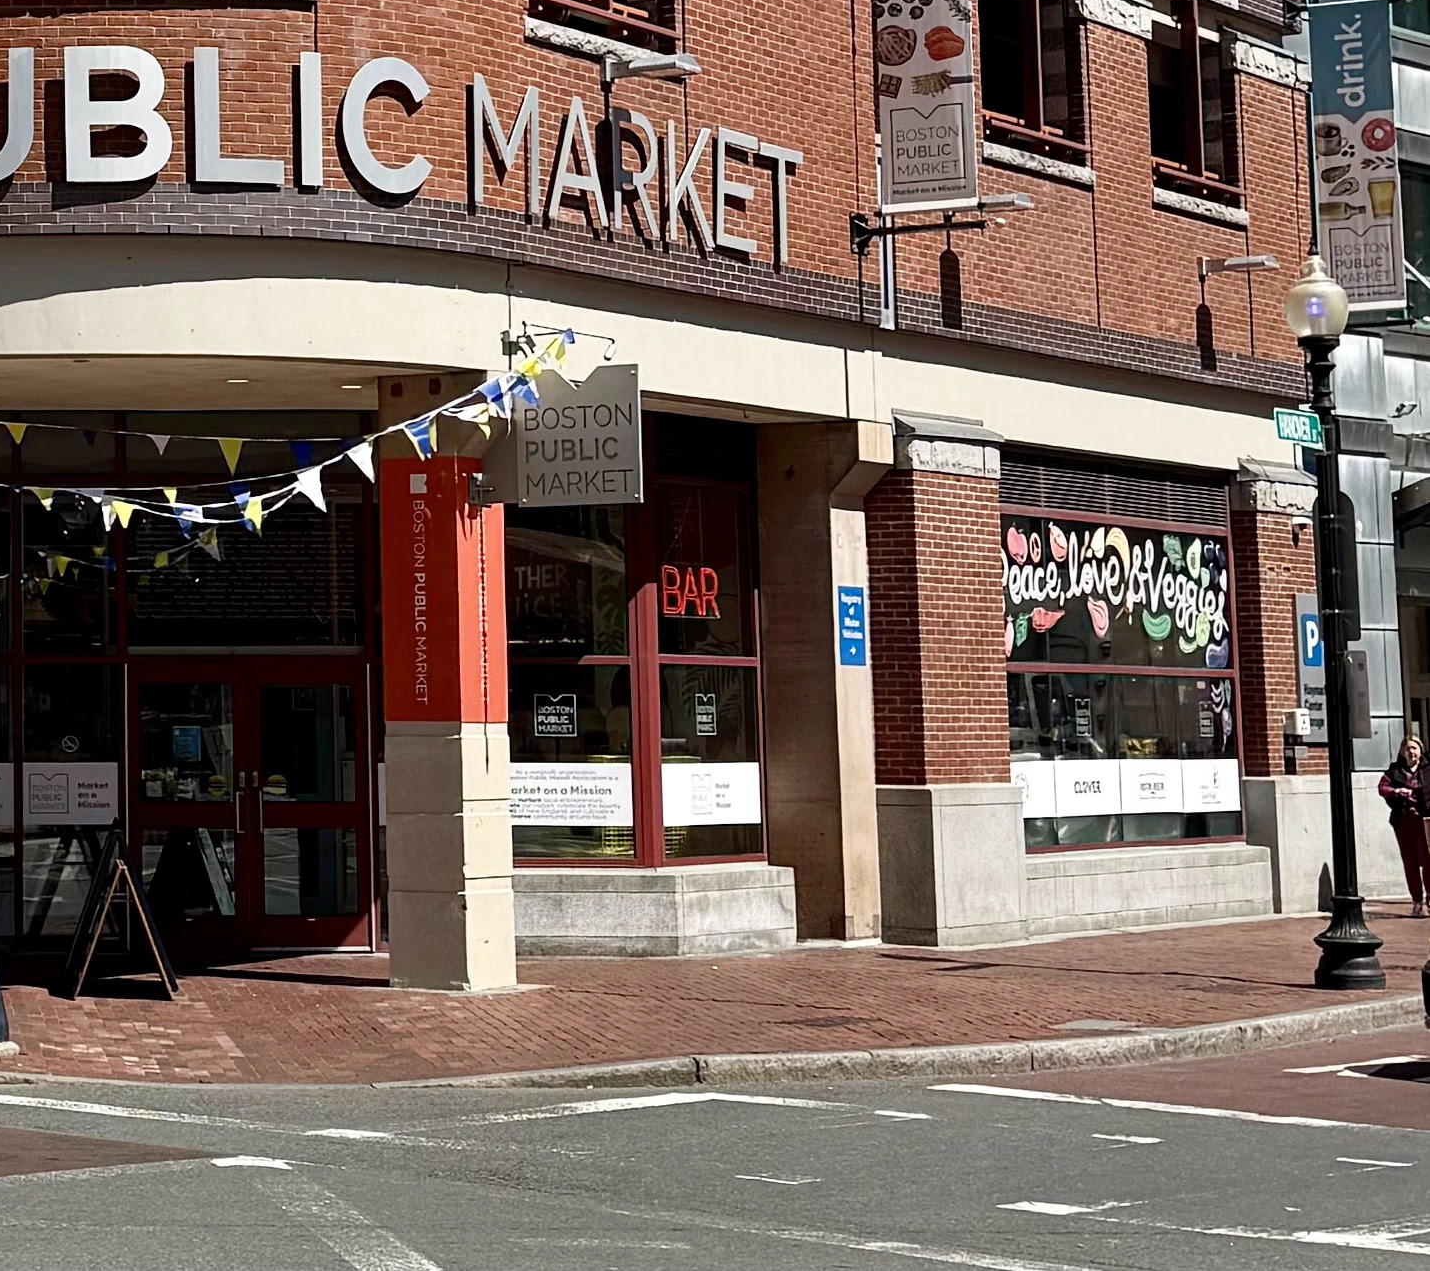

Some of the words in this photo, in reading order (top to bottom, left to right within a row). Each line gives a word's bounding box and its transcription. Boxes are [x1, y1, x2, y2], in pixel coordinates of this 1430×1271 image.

[1333, 13, 1366, 108] drink.
[896, 125, 960, 143] BOSTON
[896, 143, 951, 159] PUBLIC
[473, 72, 804, 264] MARKET
[897, 159, 960, 177] MARKET
[1334, 242, 1390, 257] BOSTON
[1335, 257, 1383, 270] PUBLIC
[1336, 269, 1392, 285] MARKET
[524, 403, 633, 432] BOSTON
[525, 436, 618, 464] PUBLIC
[526, 469, 634, 497] MARKET
[412, 500, 427, 568] BOSTON
[514, 563, 570, 591] THER
[1065, 530, 1125, 606] love
[414, 572, 427, 633] PUBLIC
[661, 564, 720, 617] BAR
[1305, 620, 1319, 658] P
[415, 636, 428, 705] MARKET
[537, 706, 574, 715] BOSTON
[538, 715, 569, 724] PUBLIC
[538, 724, 573, 733] MARKET
[511, 785, 542, 795] arket
[543, 787, 558, 796] on
[570, 784, 612, 796] Mission
